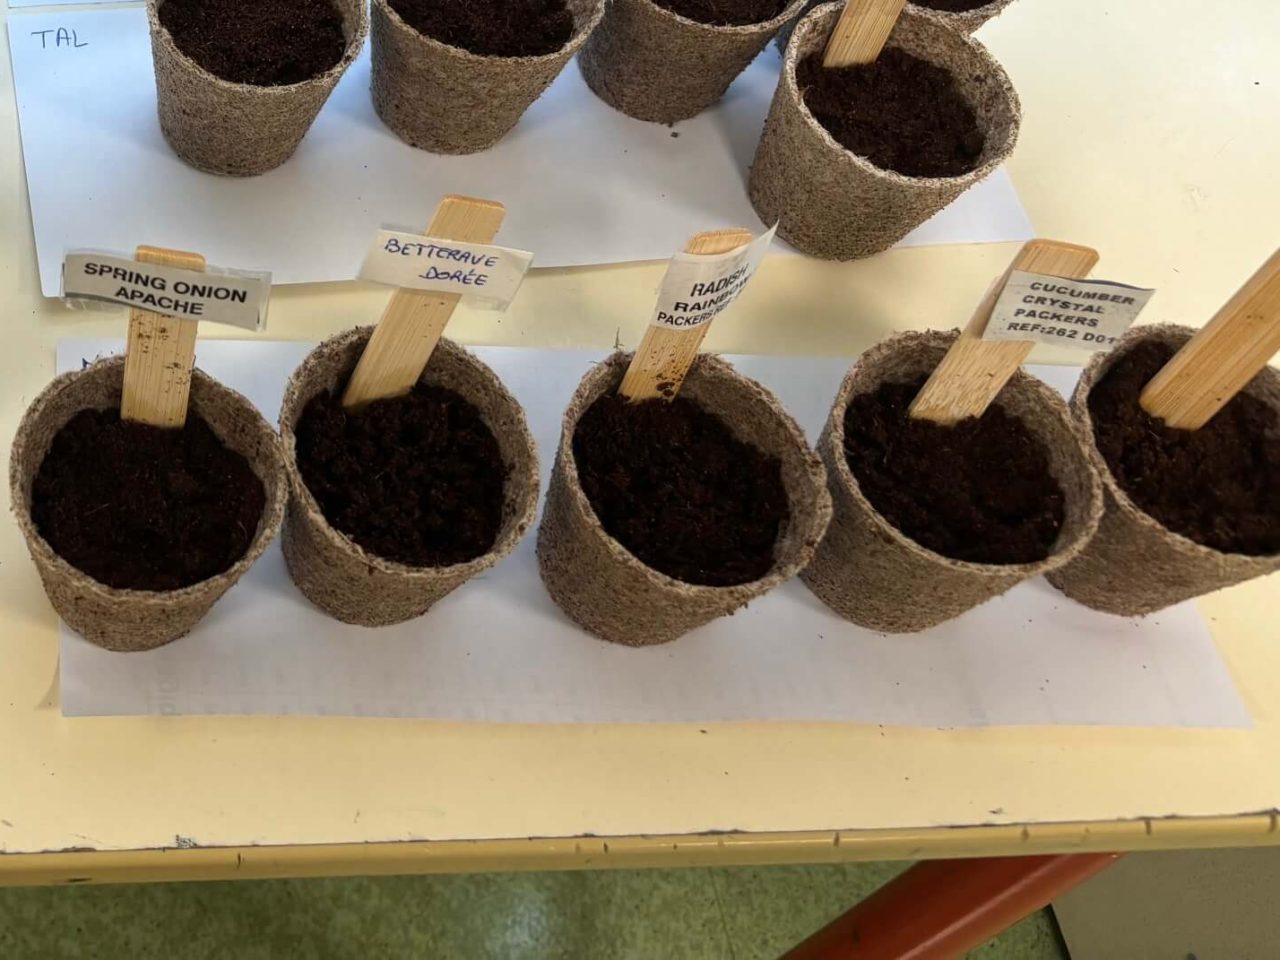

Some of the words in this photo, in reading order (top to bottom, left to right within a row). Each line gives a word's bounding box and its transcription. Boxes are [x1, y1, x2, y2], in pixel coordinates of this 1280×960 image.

[30, 26, 89, 49] TAL
[384, 238, 500, 268] BETTERAVE
[83, 262, 167, 291] SPRING
[173, 281, 248, 303] ONION
[419, 266, 489, 286] DORÉE
[690, 262, 750, 297] RADISH
[115, 286, 205, 316] APACHE
[1022, 294, 1106, 315] CRYSTAL
[1029, 281, 1137, 306] CUCUMBER
[657, 307, 714, 327] PACKERS
[1013, 308, 1100, 328] PACKERS
[1006, 321, 1081, 339] REF:262
